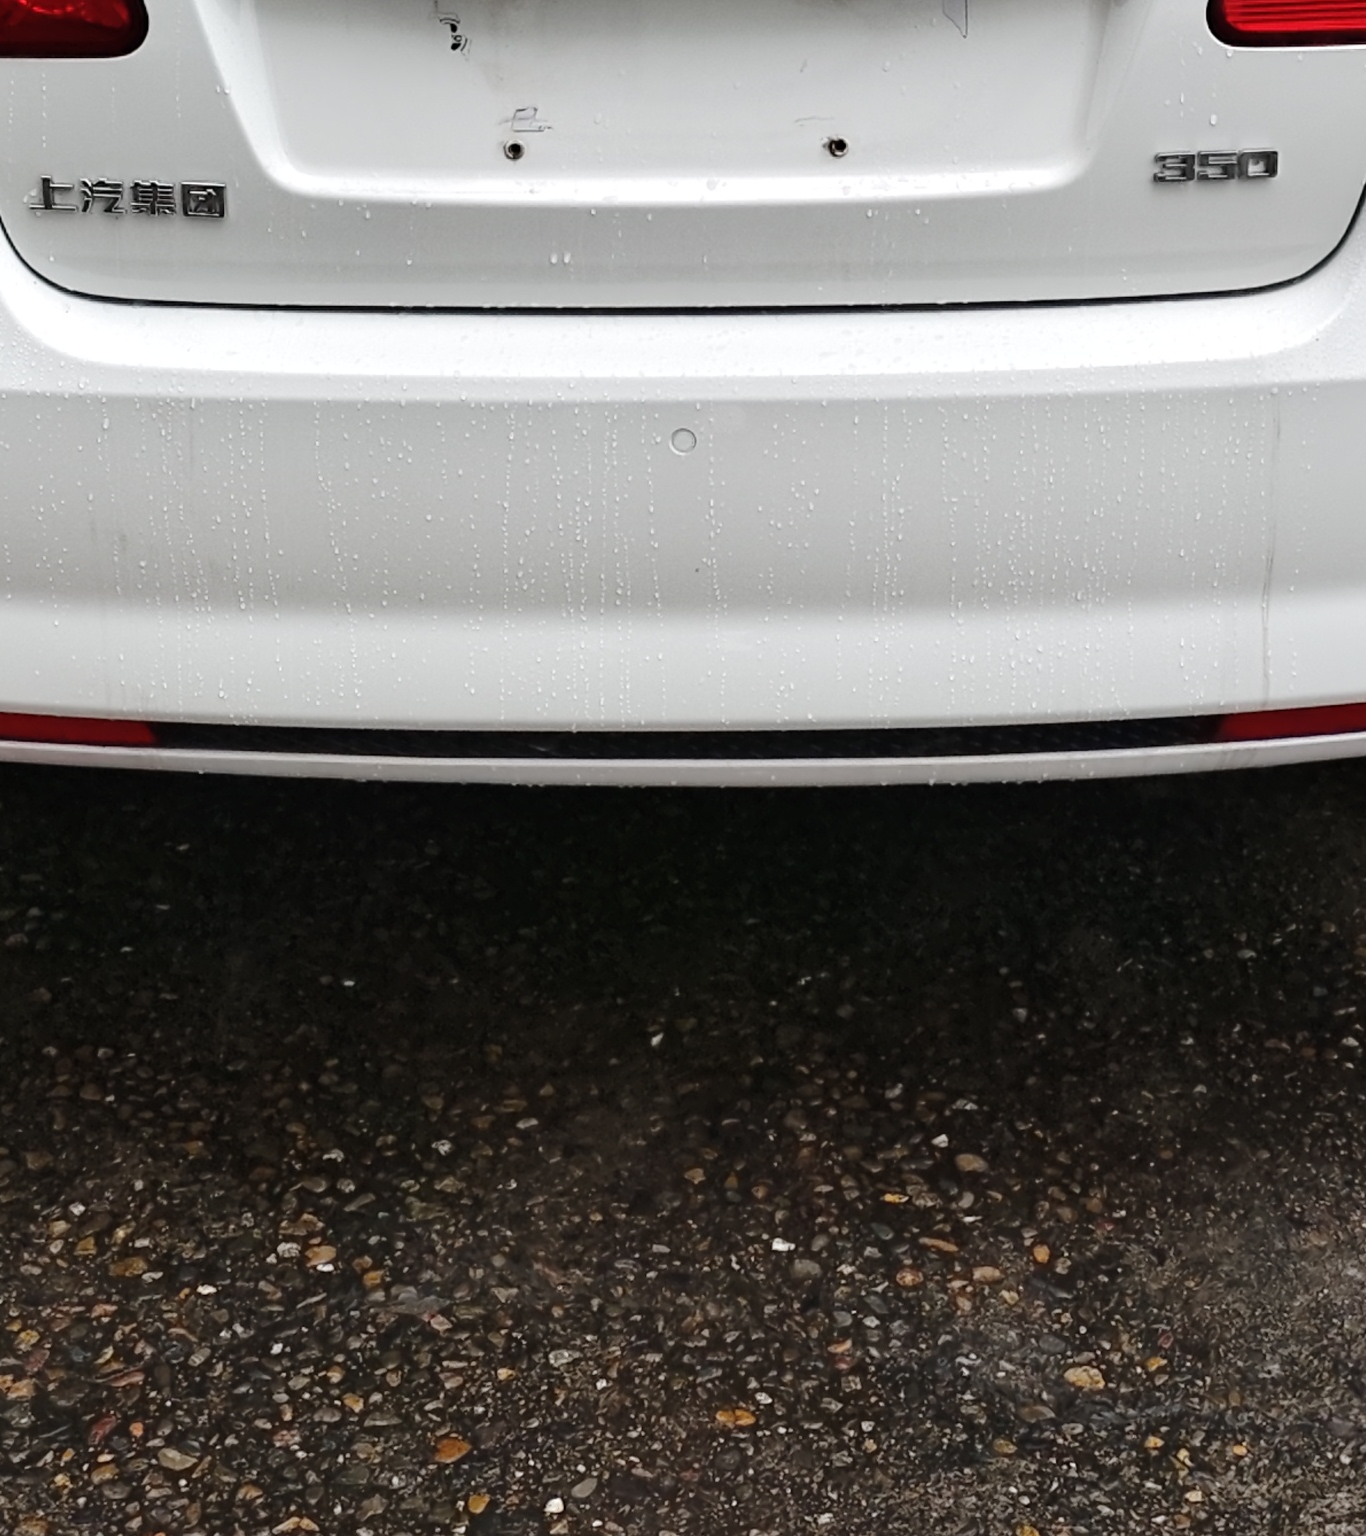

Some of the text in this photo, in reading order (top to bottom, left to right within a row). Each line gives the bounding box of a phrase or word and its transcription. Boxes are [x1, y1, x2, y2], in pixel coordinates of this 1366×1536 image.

[1154, 150, 1279, 183] 350
[29, 175, 227, 218] 上汽集团
